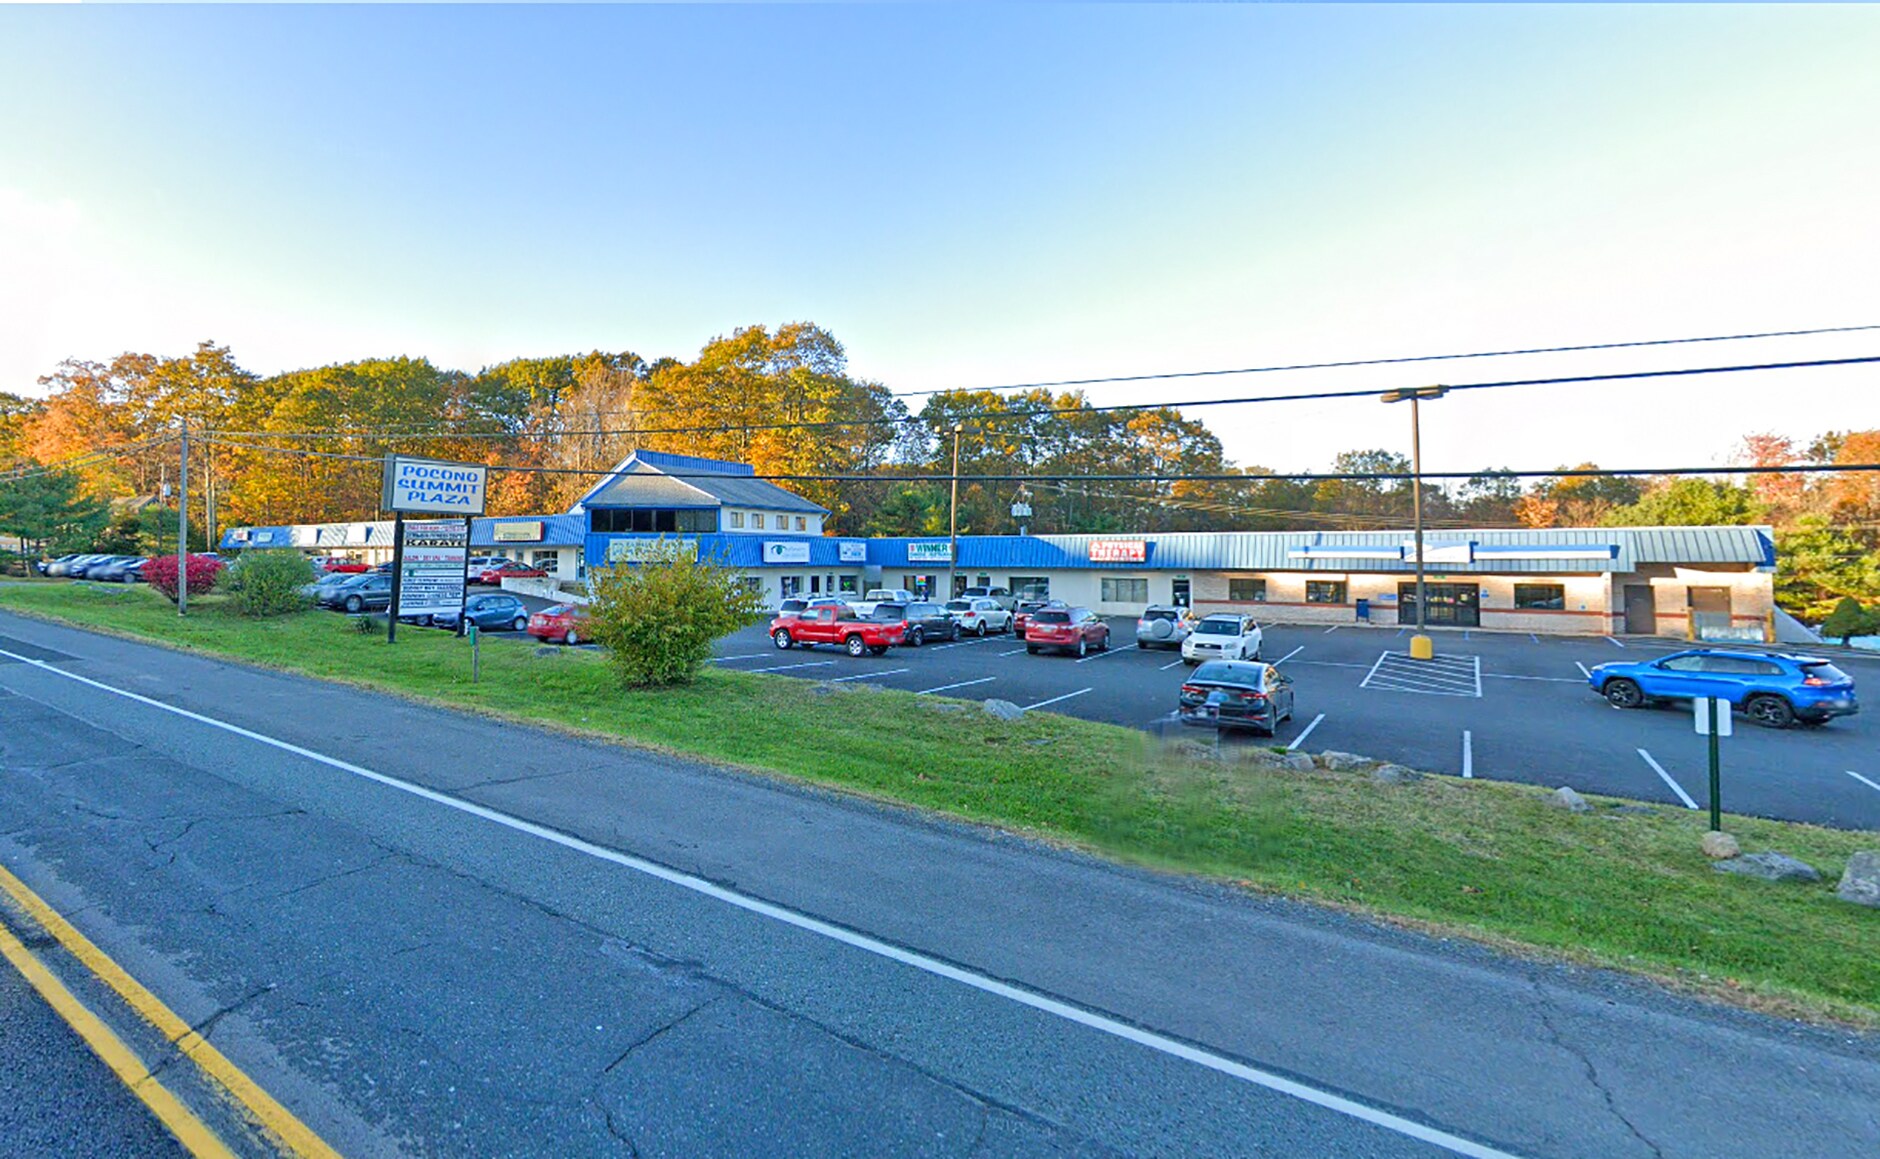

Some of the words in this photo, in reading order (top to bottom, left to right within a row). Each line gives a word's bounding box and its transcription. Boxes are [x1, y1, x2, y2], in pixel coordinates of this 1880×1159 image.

[403, 465, 478, 482] POCONO
[398, 478, 481, 494] SUMMIT
[407, 490, 470, 505] PLAZA
[406, 539, 466, 547] KARATE
[916, 544, 948, 552] WINNER
[1091, 549, 1145, 558] THERAPY
